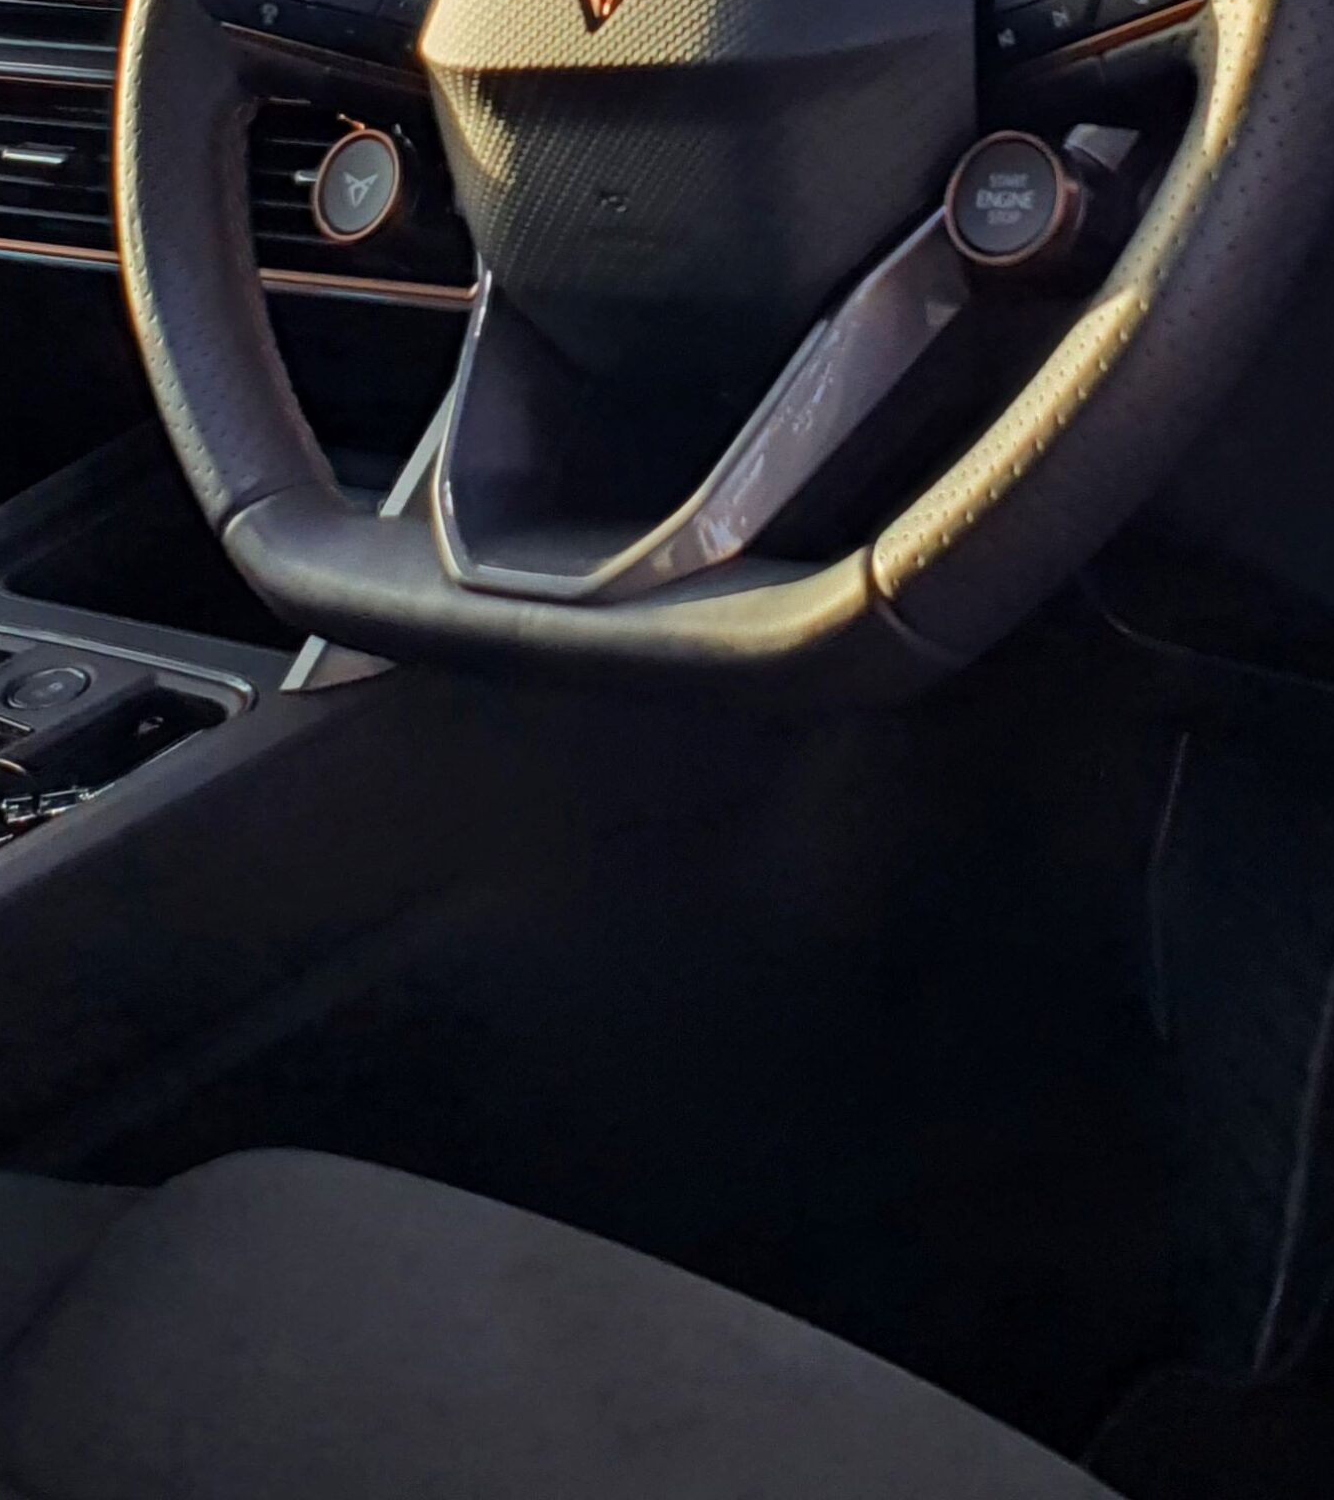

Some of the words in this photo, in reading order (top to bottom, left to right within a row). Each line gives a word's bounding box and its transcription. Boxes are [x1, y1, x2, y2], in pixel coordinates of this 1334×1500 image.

[988, 173, 1030, 188] START
[975, 189, 1036, 209] ENGINE
[986, 210, 1022, 225] STOP
